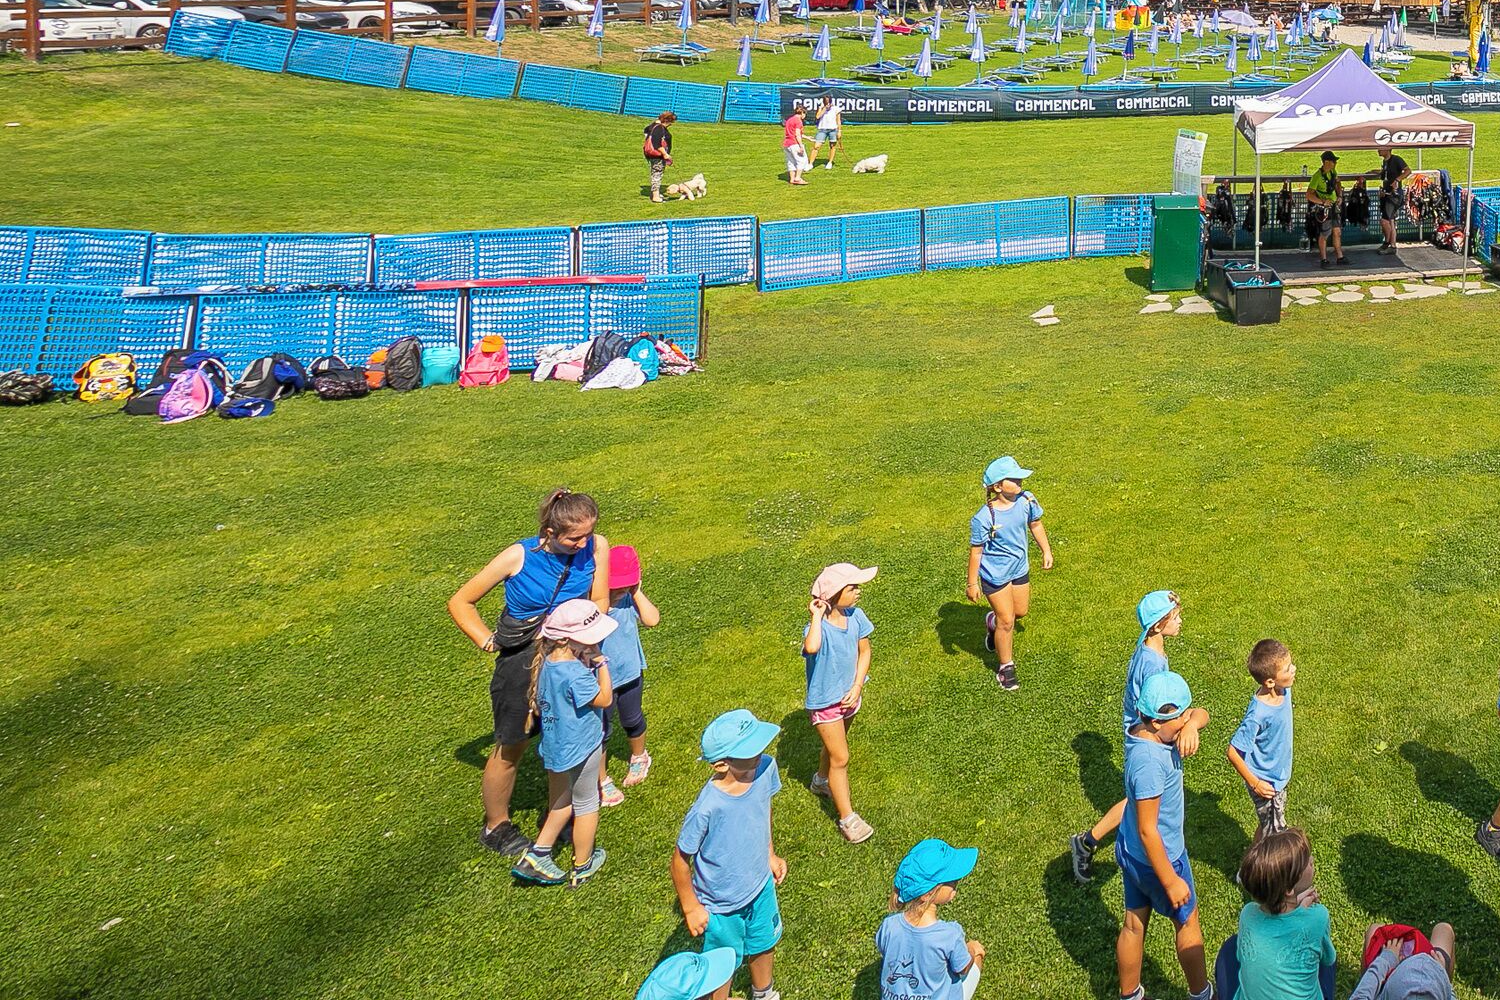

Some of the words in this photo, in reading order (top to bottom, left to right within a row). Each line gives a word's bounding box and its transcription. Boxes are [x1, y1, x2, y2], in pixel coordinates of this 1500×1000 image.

[907, 99, 994, 113] COMMENCAL
[1015, 98, 1096, 112] COMMENCAL
[1116, 96, 1192, 110] COMMENCAL
